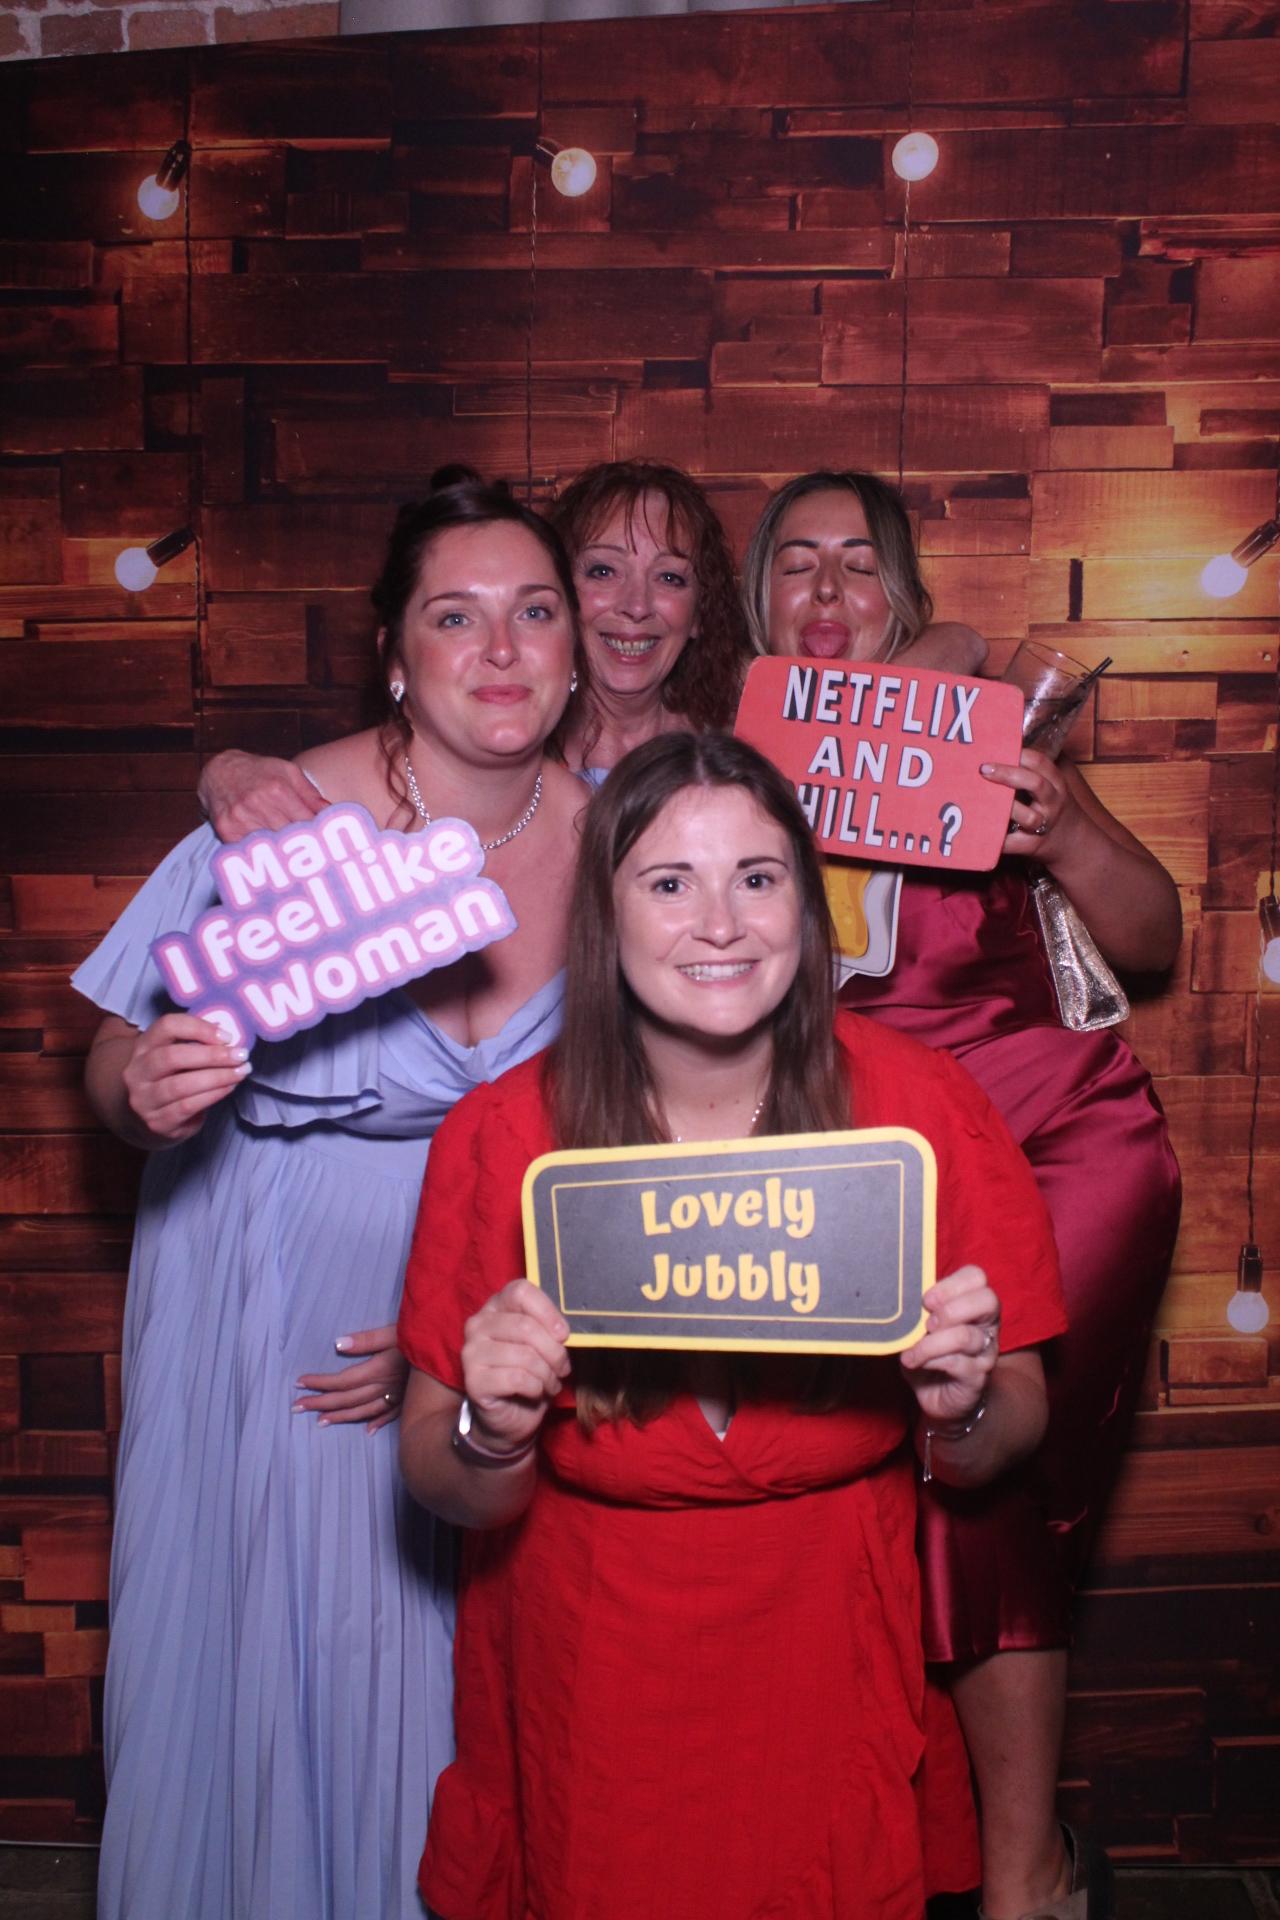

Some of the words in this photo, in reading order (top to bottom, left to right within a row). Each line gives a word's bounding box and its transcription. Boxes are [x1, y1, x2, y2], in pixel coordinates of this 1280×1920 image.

[782, 664, 980, 743] NETFLIX
[807, 735, 933, 788] AND
[796, 784, 963, 857] HILL...?
[222, 814, 369, 906] Man
[165, 944, 198, 995] I
[202, 876, 341, 978] feel
[341, 828, 471, 912] like
[640, 1177, 816, 1239] Lovely
[640, 1250, 820, 1314] Jubbly
